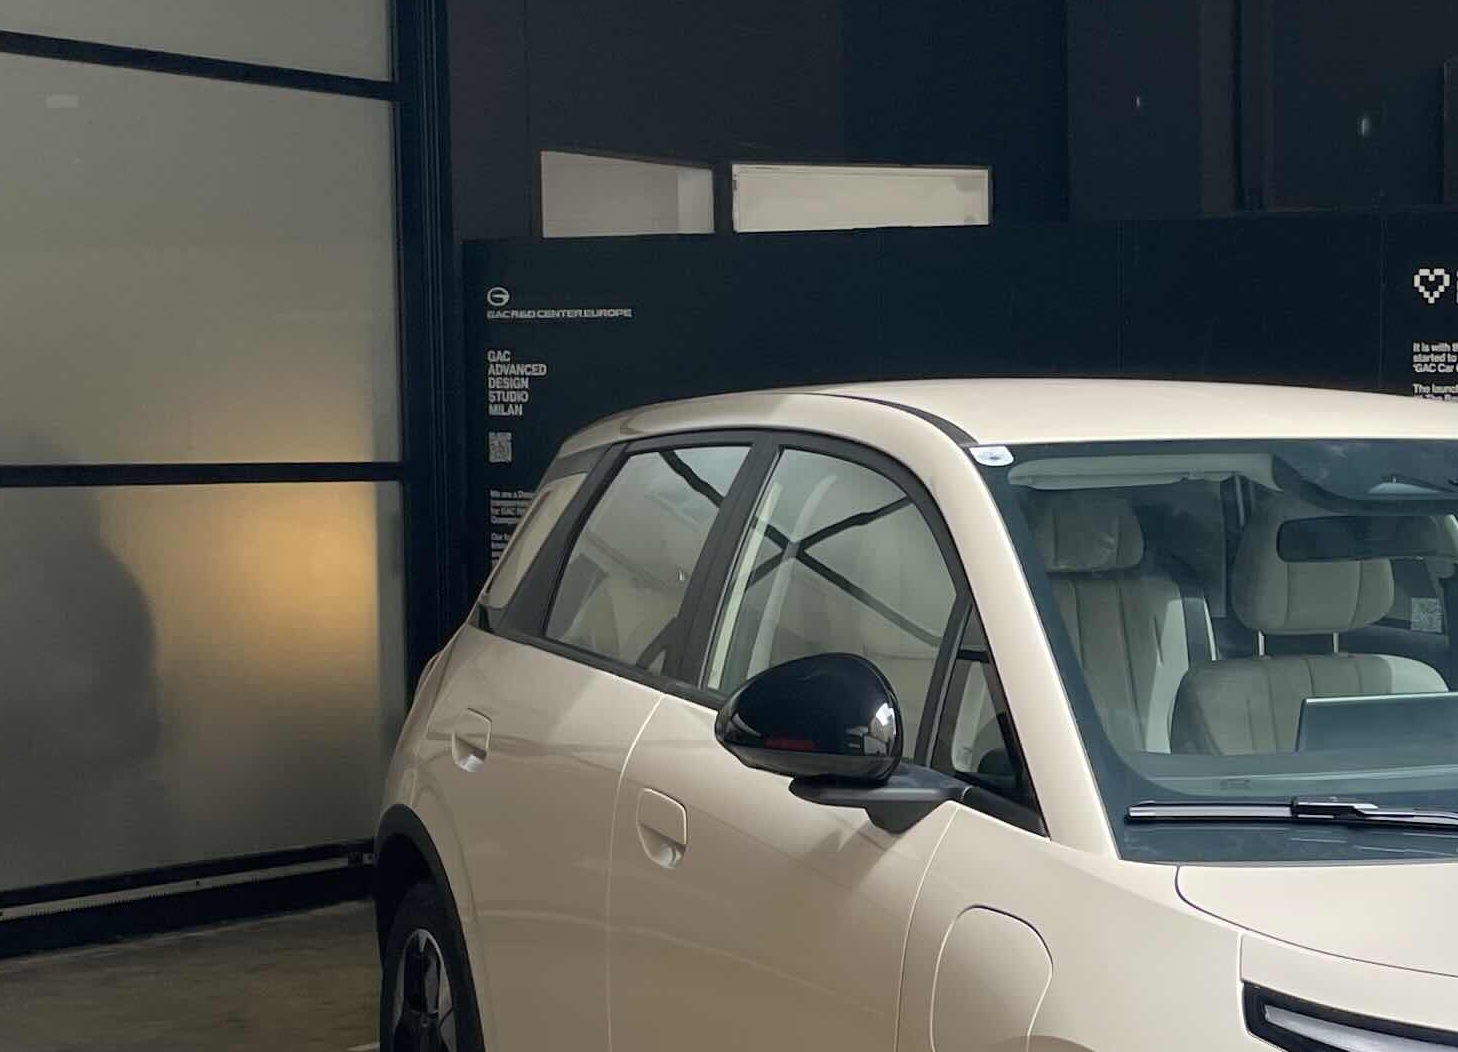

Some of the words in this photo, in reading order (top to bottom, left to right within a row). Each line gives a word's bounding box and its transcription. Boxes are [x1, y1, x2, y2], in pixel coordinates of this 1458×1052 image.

[1431, 342, 1450, 352] with
[487, 350, 511, 362] GAC
[1413, 353, 1446, 363] started
[1447, 353, 1457, 363] to
[488, 363, 548, 376] ADVANCED
[1438, 363, 1454, 373] Car
[488, 376, 529, 389] DESIGN
[1413, 384, 1430, 394] The
[489, 390, 530, 403] STUDIO
[489, 403, 523, 416] MILAN
